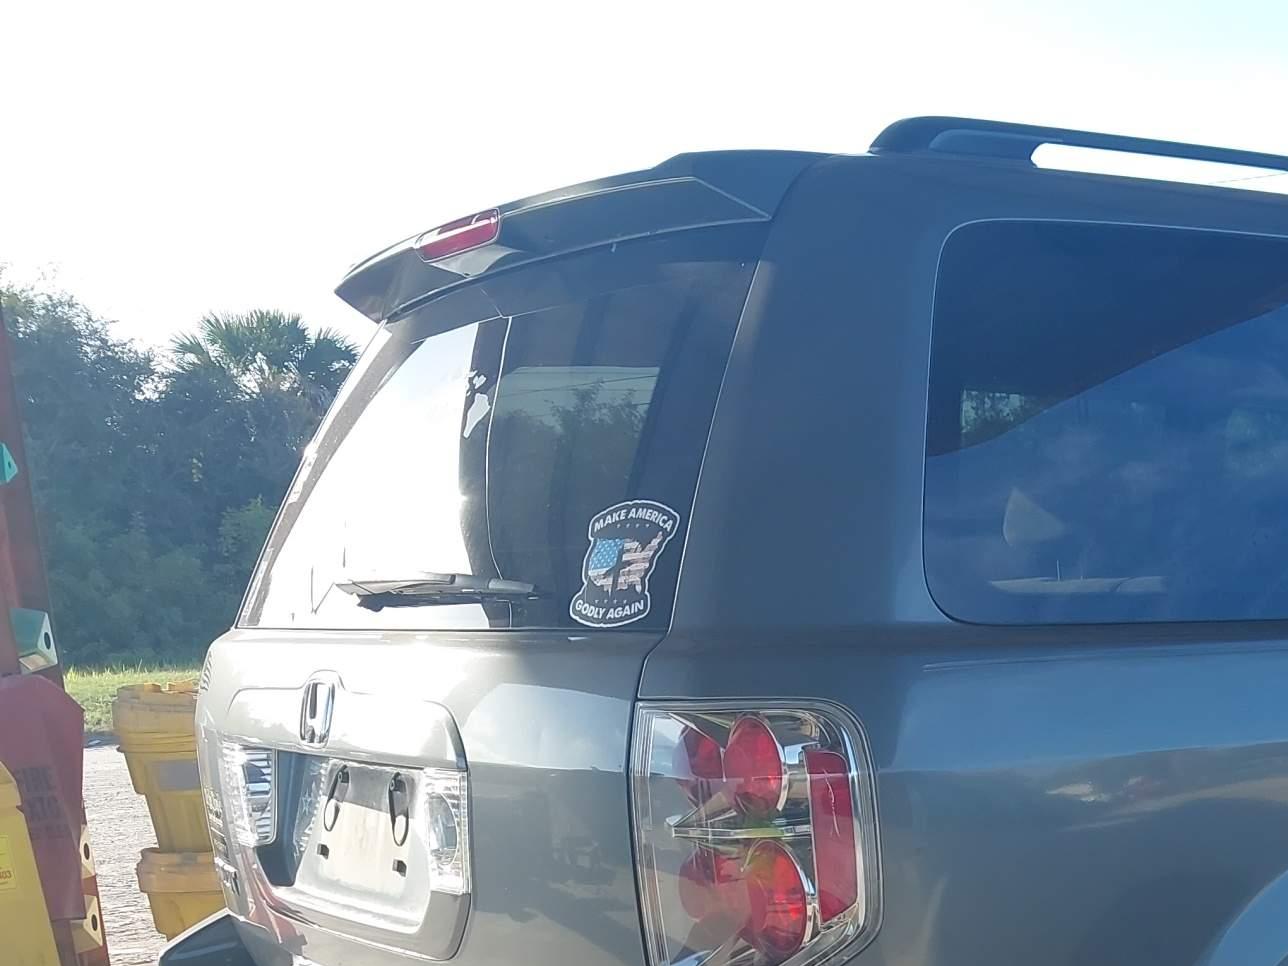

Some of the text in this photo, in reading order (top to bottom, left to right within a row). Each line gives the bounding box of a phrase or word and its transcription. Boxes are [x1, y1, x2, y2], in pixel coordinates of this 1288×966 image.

[593, 506, 674, 533] MAKE AMERICA
[575, 598, 644, 620] GODLY AGAIN
